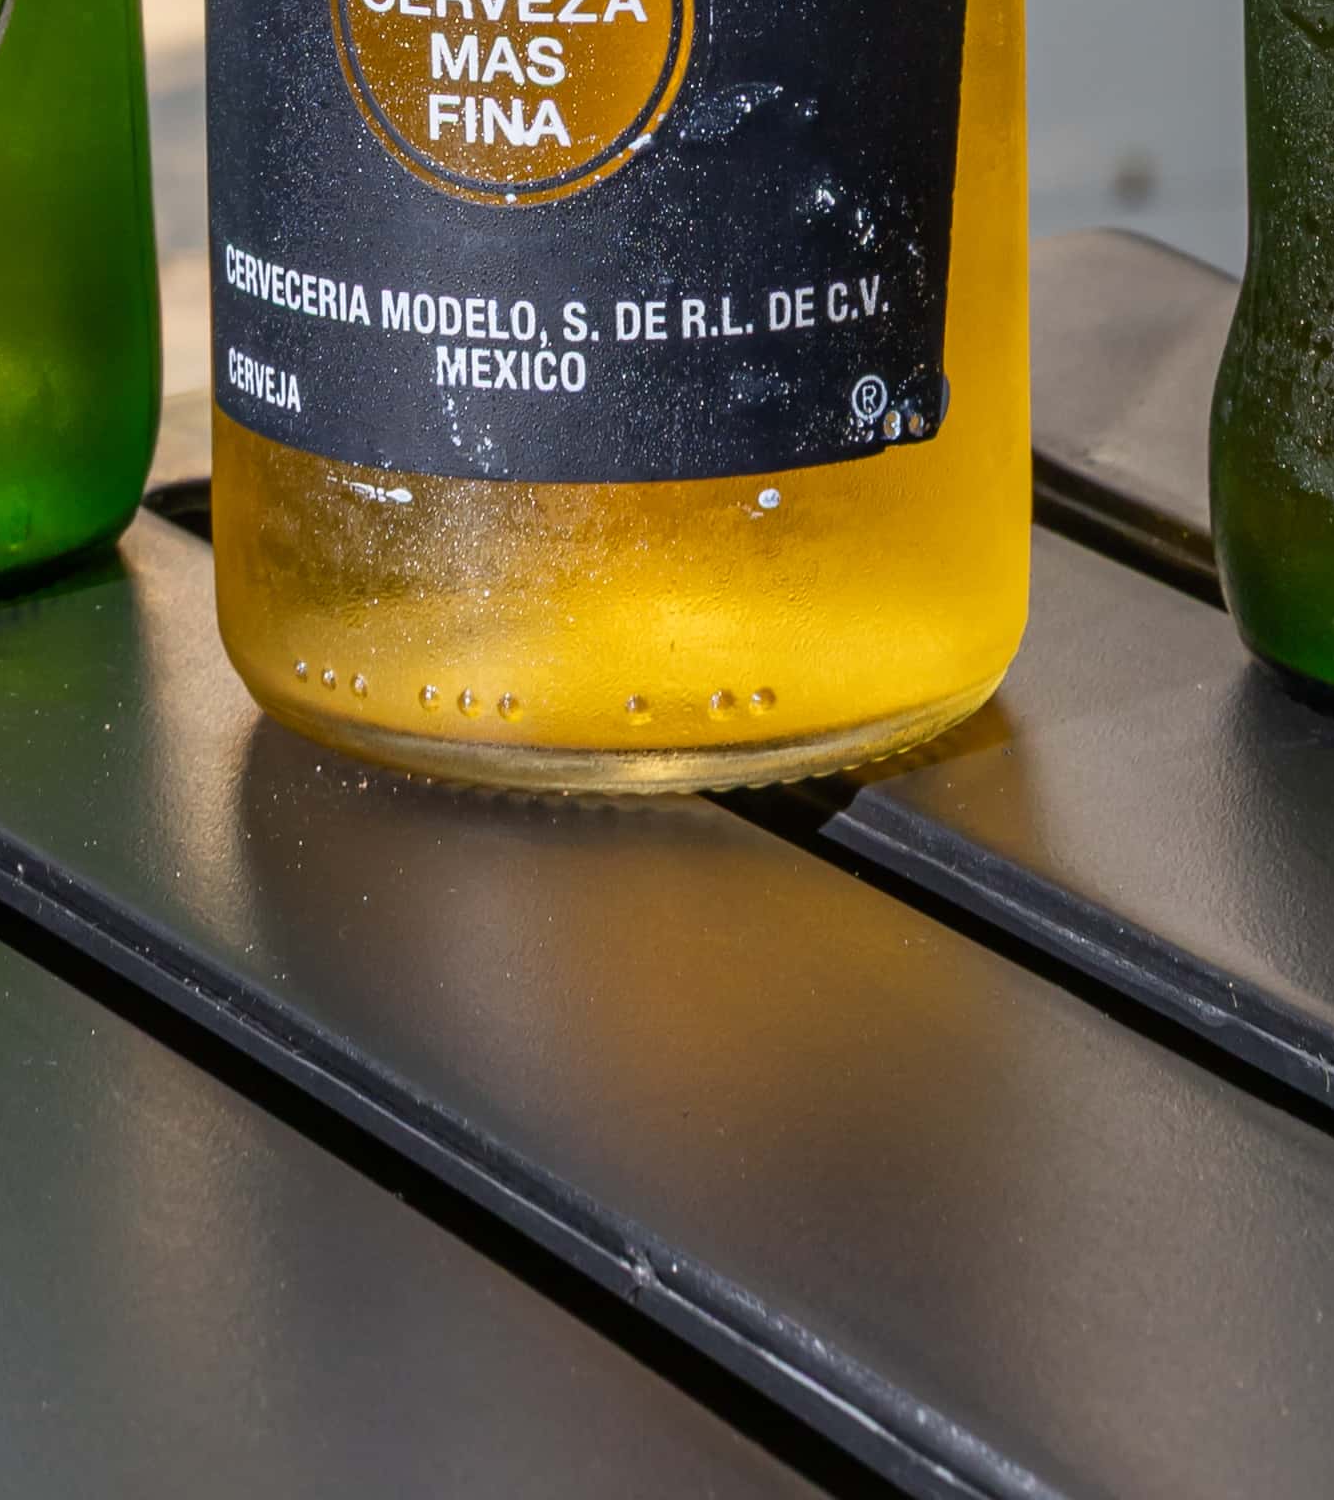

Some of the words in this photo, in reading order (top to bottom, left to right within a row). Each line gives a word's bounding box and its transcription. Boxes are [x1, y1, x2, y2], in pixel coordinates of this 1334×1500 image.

[428, 33, 566, 86] MAS
[427, 94, 572, 148] FINA
[225, 243, 372, 326] CERVECERIA
[380, 288, 549, 349] MODELO,
[562, 301, 600, 343] S.
[616, 301, 668, 342] DE
[681, 297, 754, 340] R.L.
[769, 286, 816, 333] DE
[826, 275, 890, 324] C.V.
[228, 347, 303, 414] CERVEJA
[436, 345, 587, 393] MEXICO
